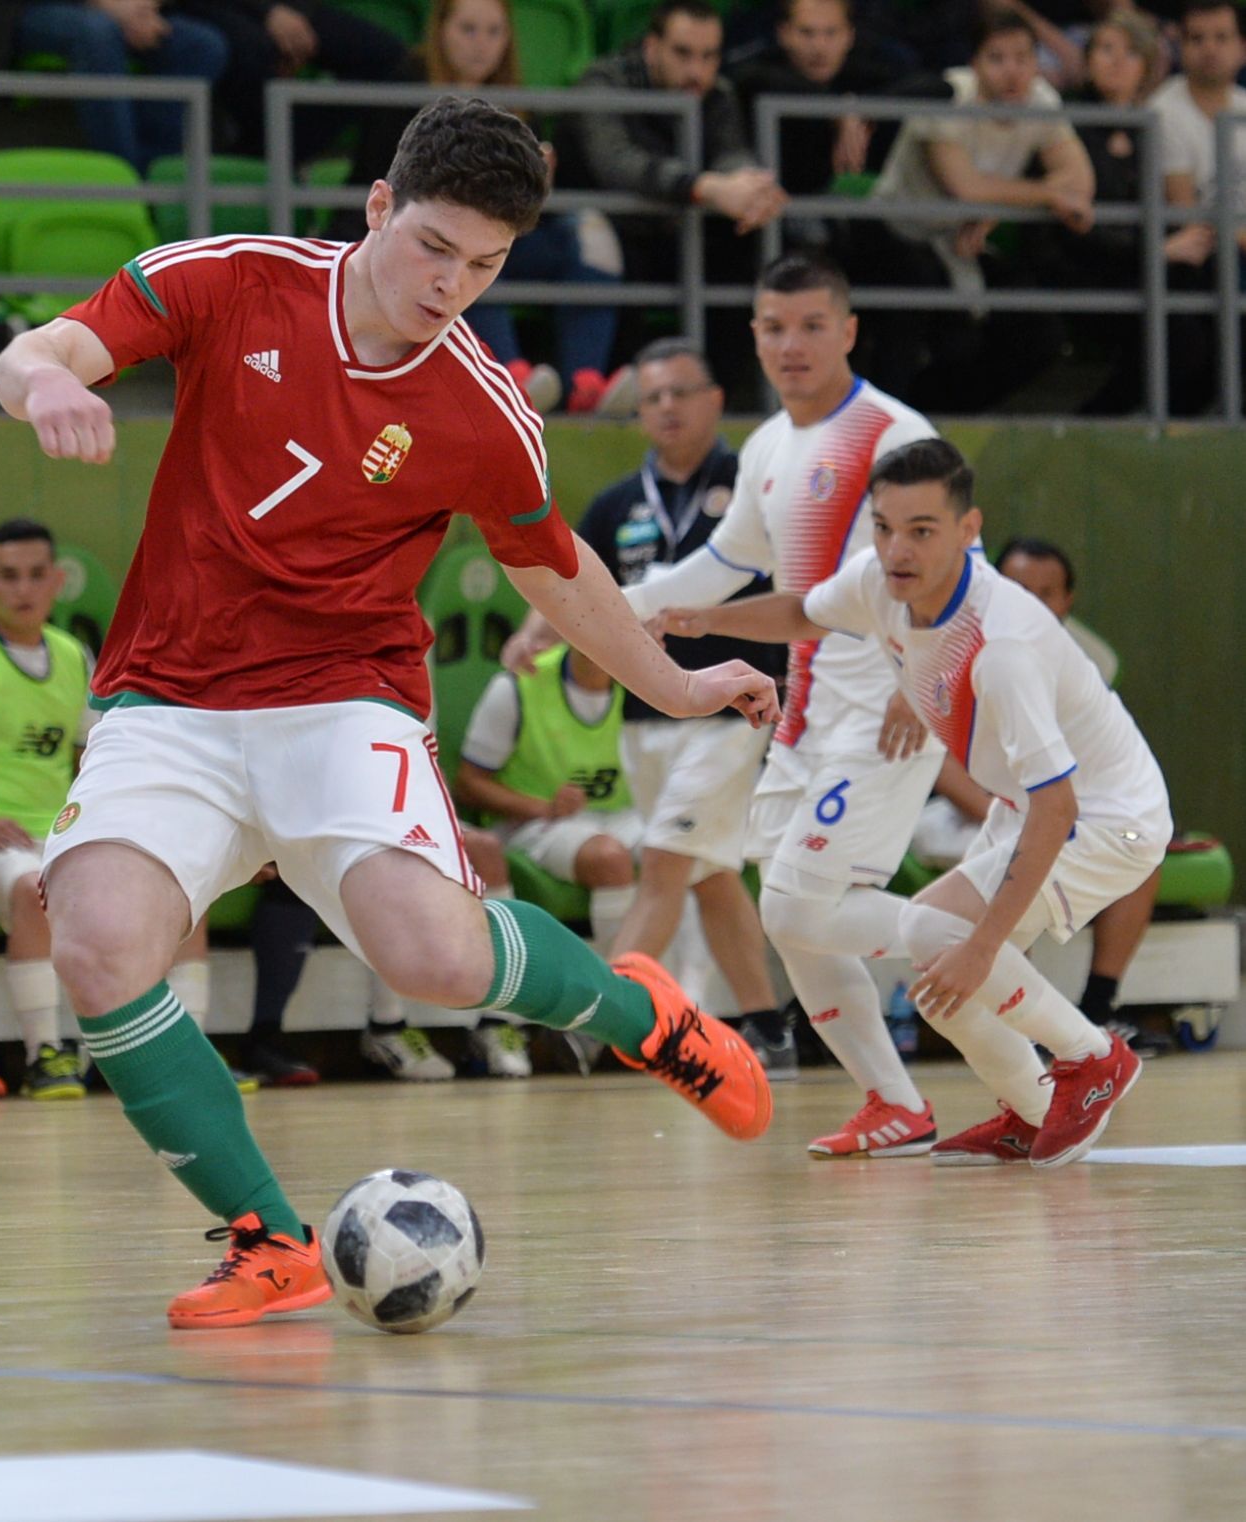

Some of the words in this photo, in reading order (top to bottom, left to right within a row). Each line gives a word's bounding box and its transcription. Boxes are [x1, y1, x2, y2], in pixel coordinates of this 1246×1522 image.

[244, 354, 282, 383] adidas
[248, 439, 323, 520] 7
[371, 743, 409, 812] 7
[816, 779, 850, 826] 6
